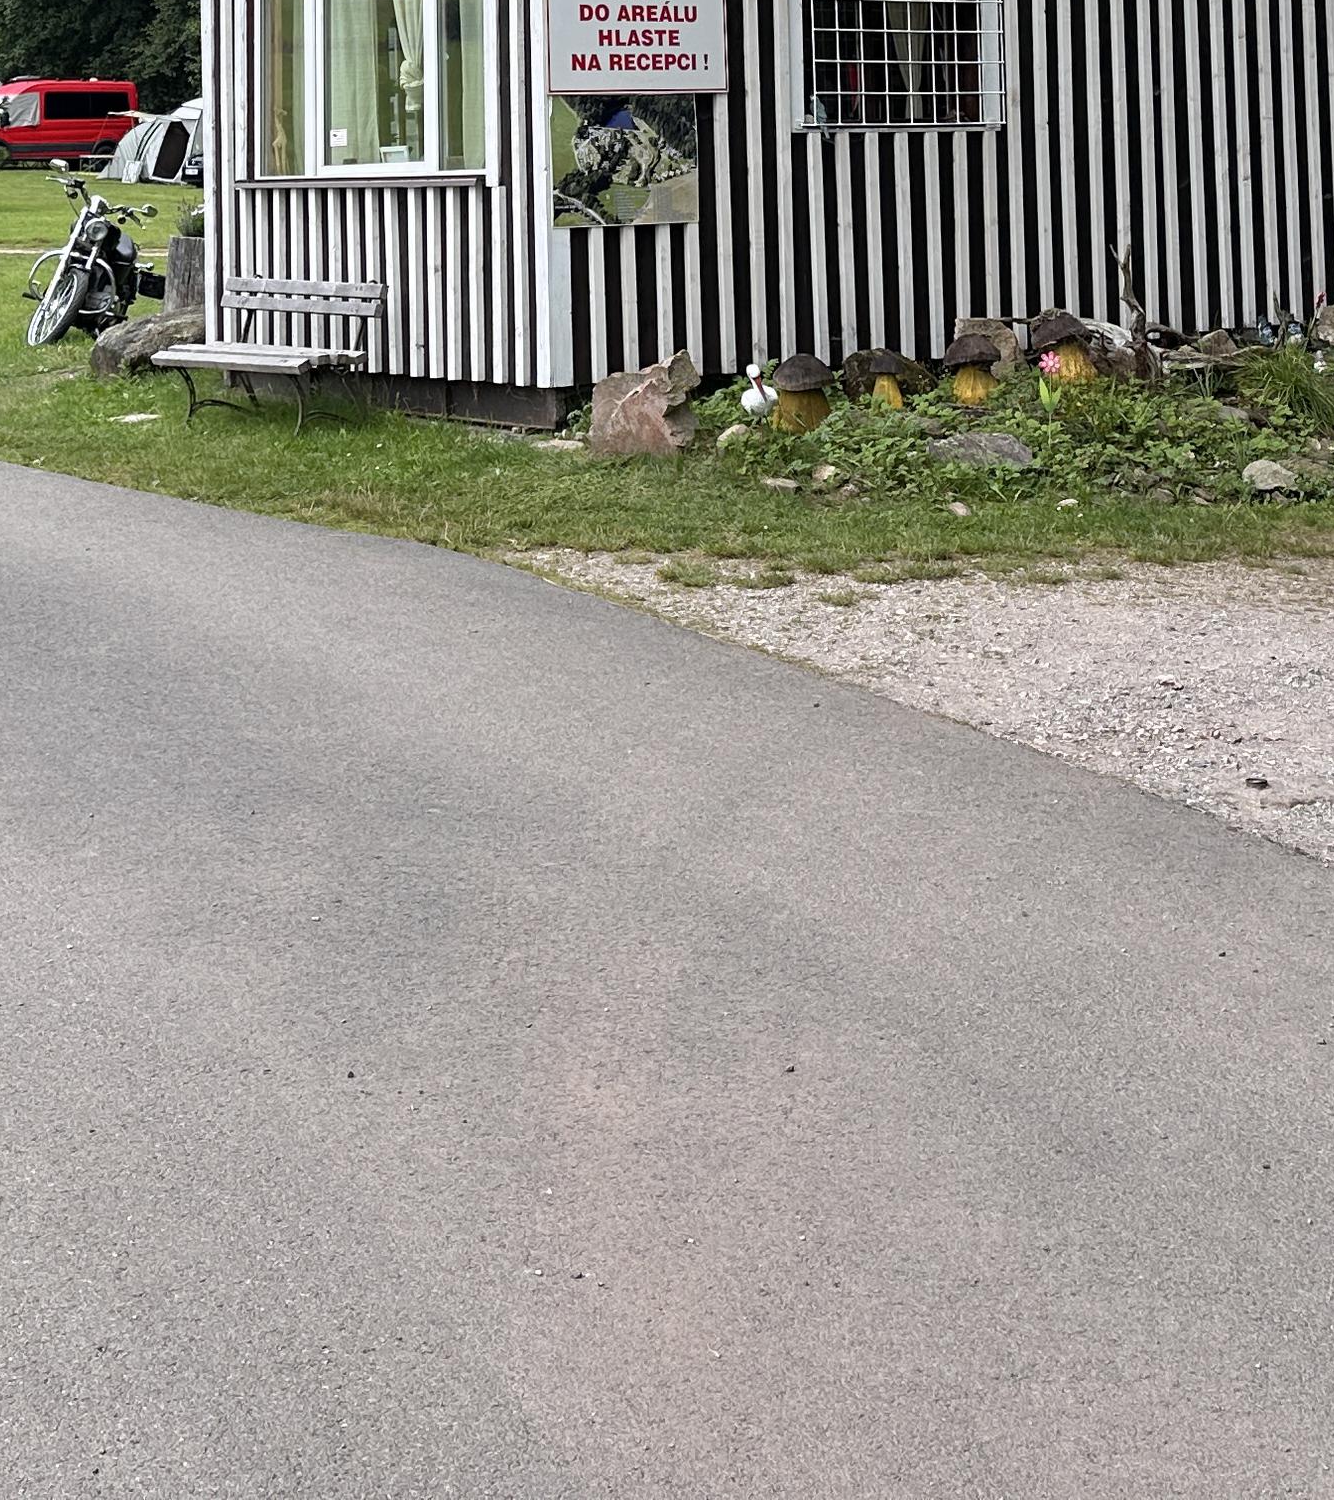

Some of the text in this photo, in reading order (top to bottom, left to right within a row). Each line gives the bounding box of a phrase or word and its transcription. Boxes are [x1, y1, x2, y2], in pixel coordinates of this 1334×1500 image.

[579, 0, 698, 23] DO AREÁLU
[598, 29, 681, 47] HLASTE
[571, 53, 602, 71] NA
[609, 53, 697, 71] RECEPCI
